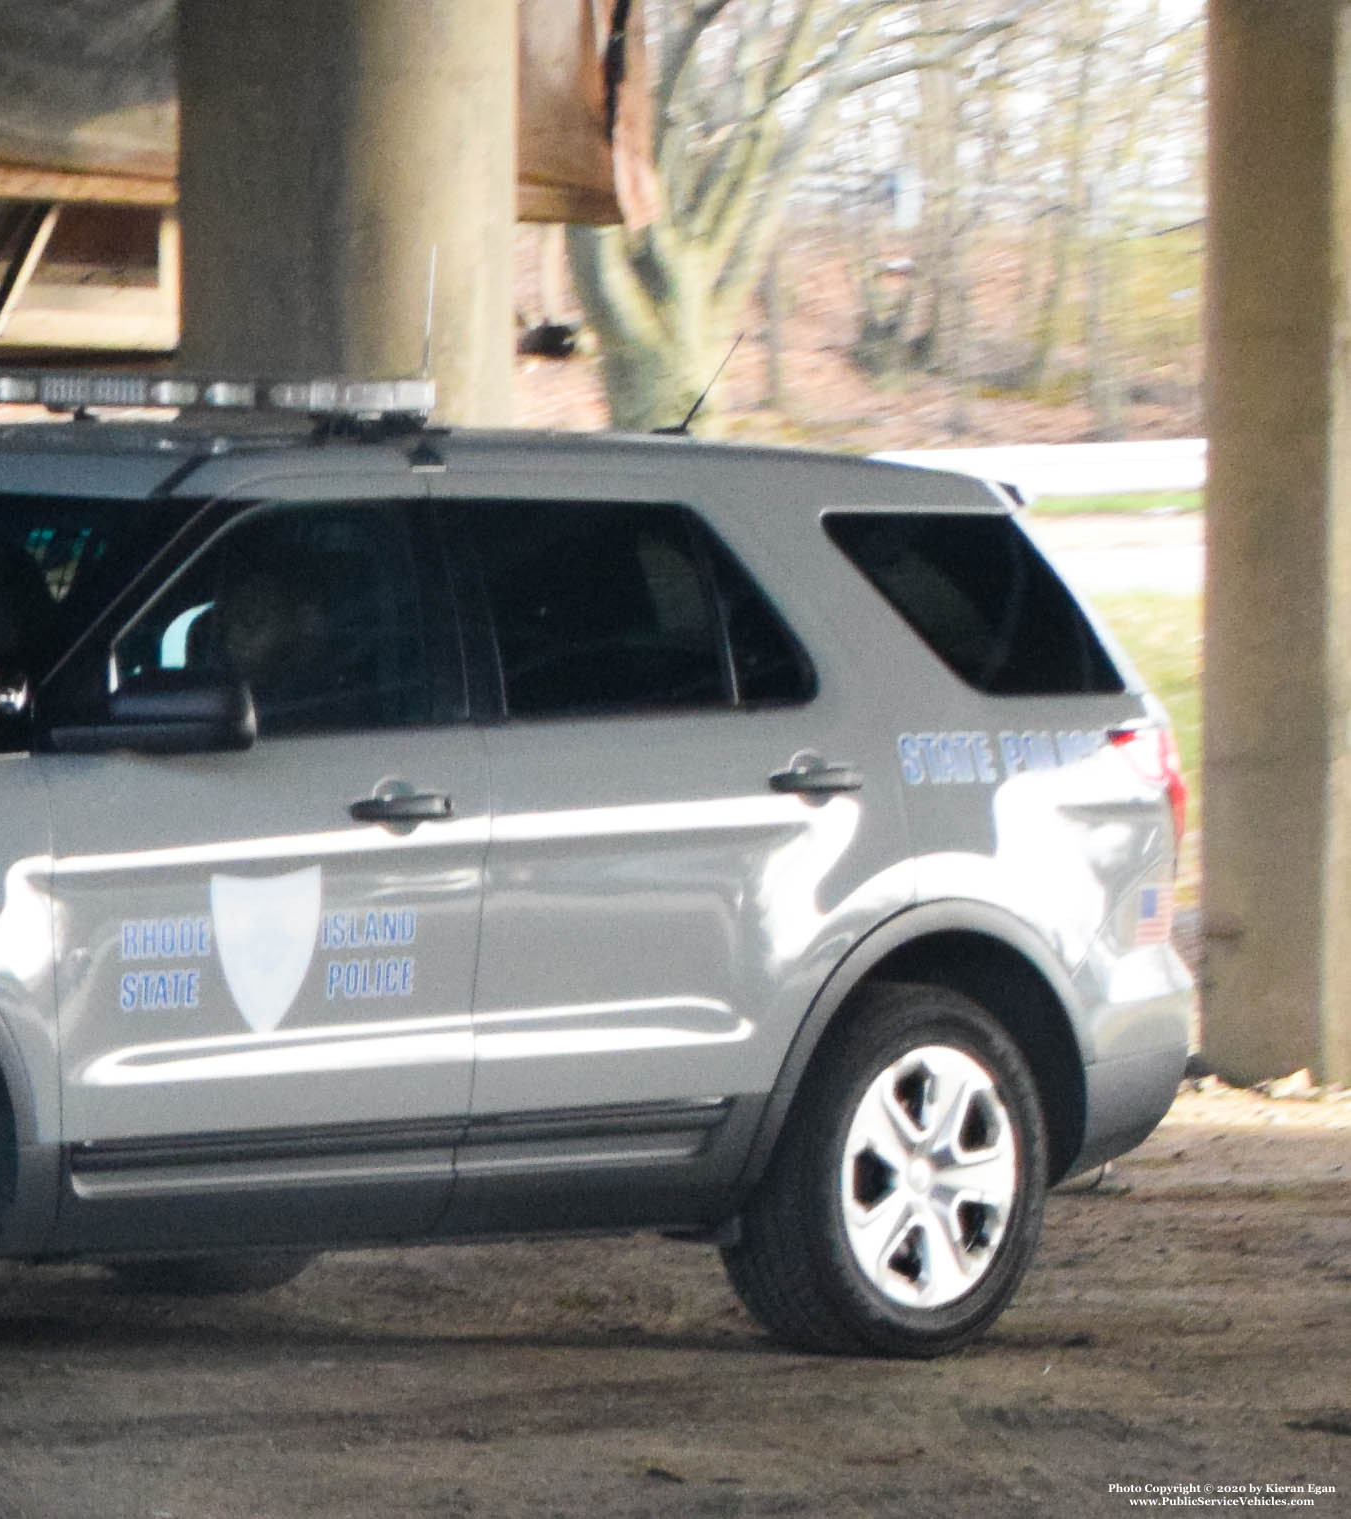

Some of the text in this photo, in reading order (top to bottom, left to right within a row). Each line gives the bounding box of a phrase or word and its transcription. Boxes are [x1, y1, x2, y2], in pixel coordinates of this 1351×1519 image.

[898, 731, 997, 784] STATE
[121, 908, 418, 959] RHODE ISLAND
[119, 957, 415, 1012] STATE POLICE
